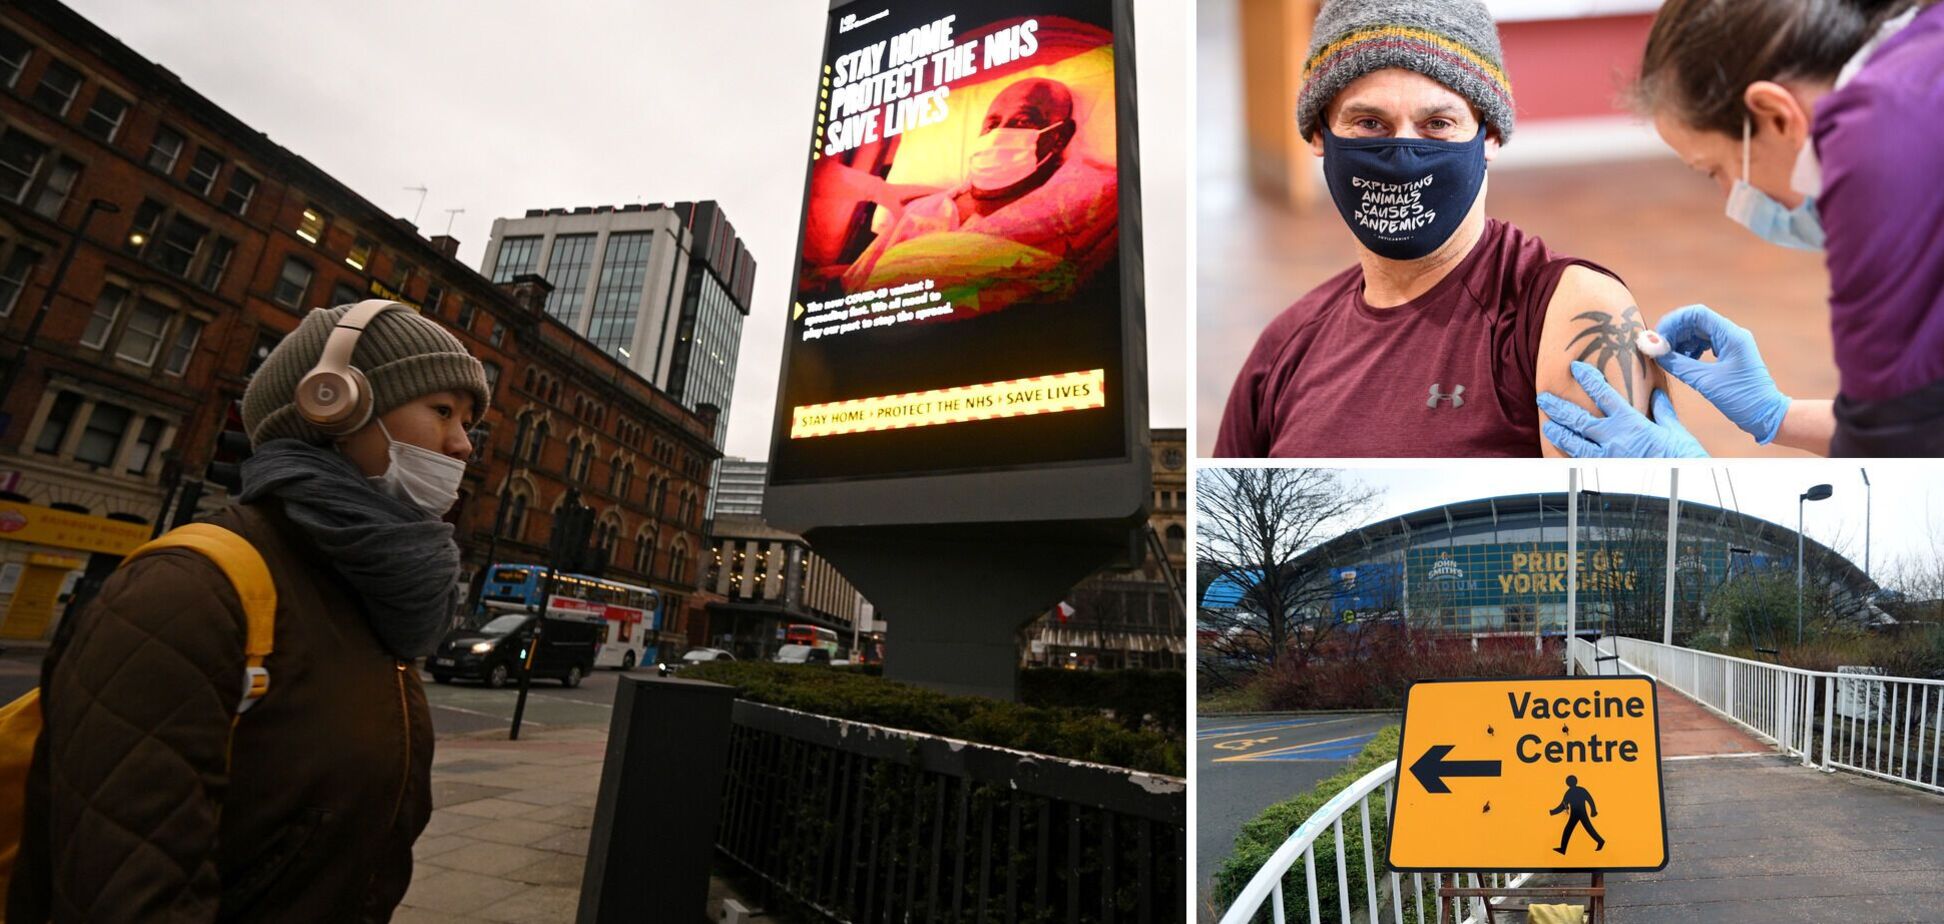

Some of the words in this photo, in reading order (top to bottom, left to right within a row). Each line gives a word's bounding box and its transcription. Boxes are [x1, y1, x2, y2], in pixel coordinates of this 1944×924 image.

[833, 40, 887, 88] STAY
[888, 14, 956, 68] HOME
[829, 58, 928, 121] PROTECT
[931, 39, 978, 87] THE
[983, 18, 1038, 70] NHS
[824, 108, 881, 156] SAVE
[883, 85, 950, 139] LIVES
[1352, 174, 1434, 193] EXPLOITING
[1362, 189, 1422, 205] ANIMALS
[1354, 209, 1436, 234] PANDEMICS
[1361, 201, 1424, 219] CAUSES
[802, 415, 828, 427] STAY
[831, 410, 864, 423] HOME
[877, 403, 931, 418] PROTECT
[937, 399, 960, 412] THE
[966, 395, 993, 409] NHS
[1006, 389, 1043, 405] SAVE
[1047, 384, 1090, 400] LIVES
[1428, 567, 1463, 579] SMITH'S
[1433, 560, 1457, 569] JOHN
[1512, 551, 1587, 573] PRIDE
[1593, 550, 1624, 571] OF
[1417, 579, 1477, 592] STADIUM
[1498, 571, 1637, 594] YORKHIRE
[1508, 690, 1645, 719] Vaccine
[1516, 734, 1638, 763] Centre
